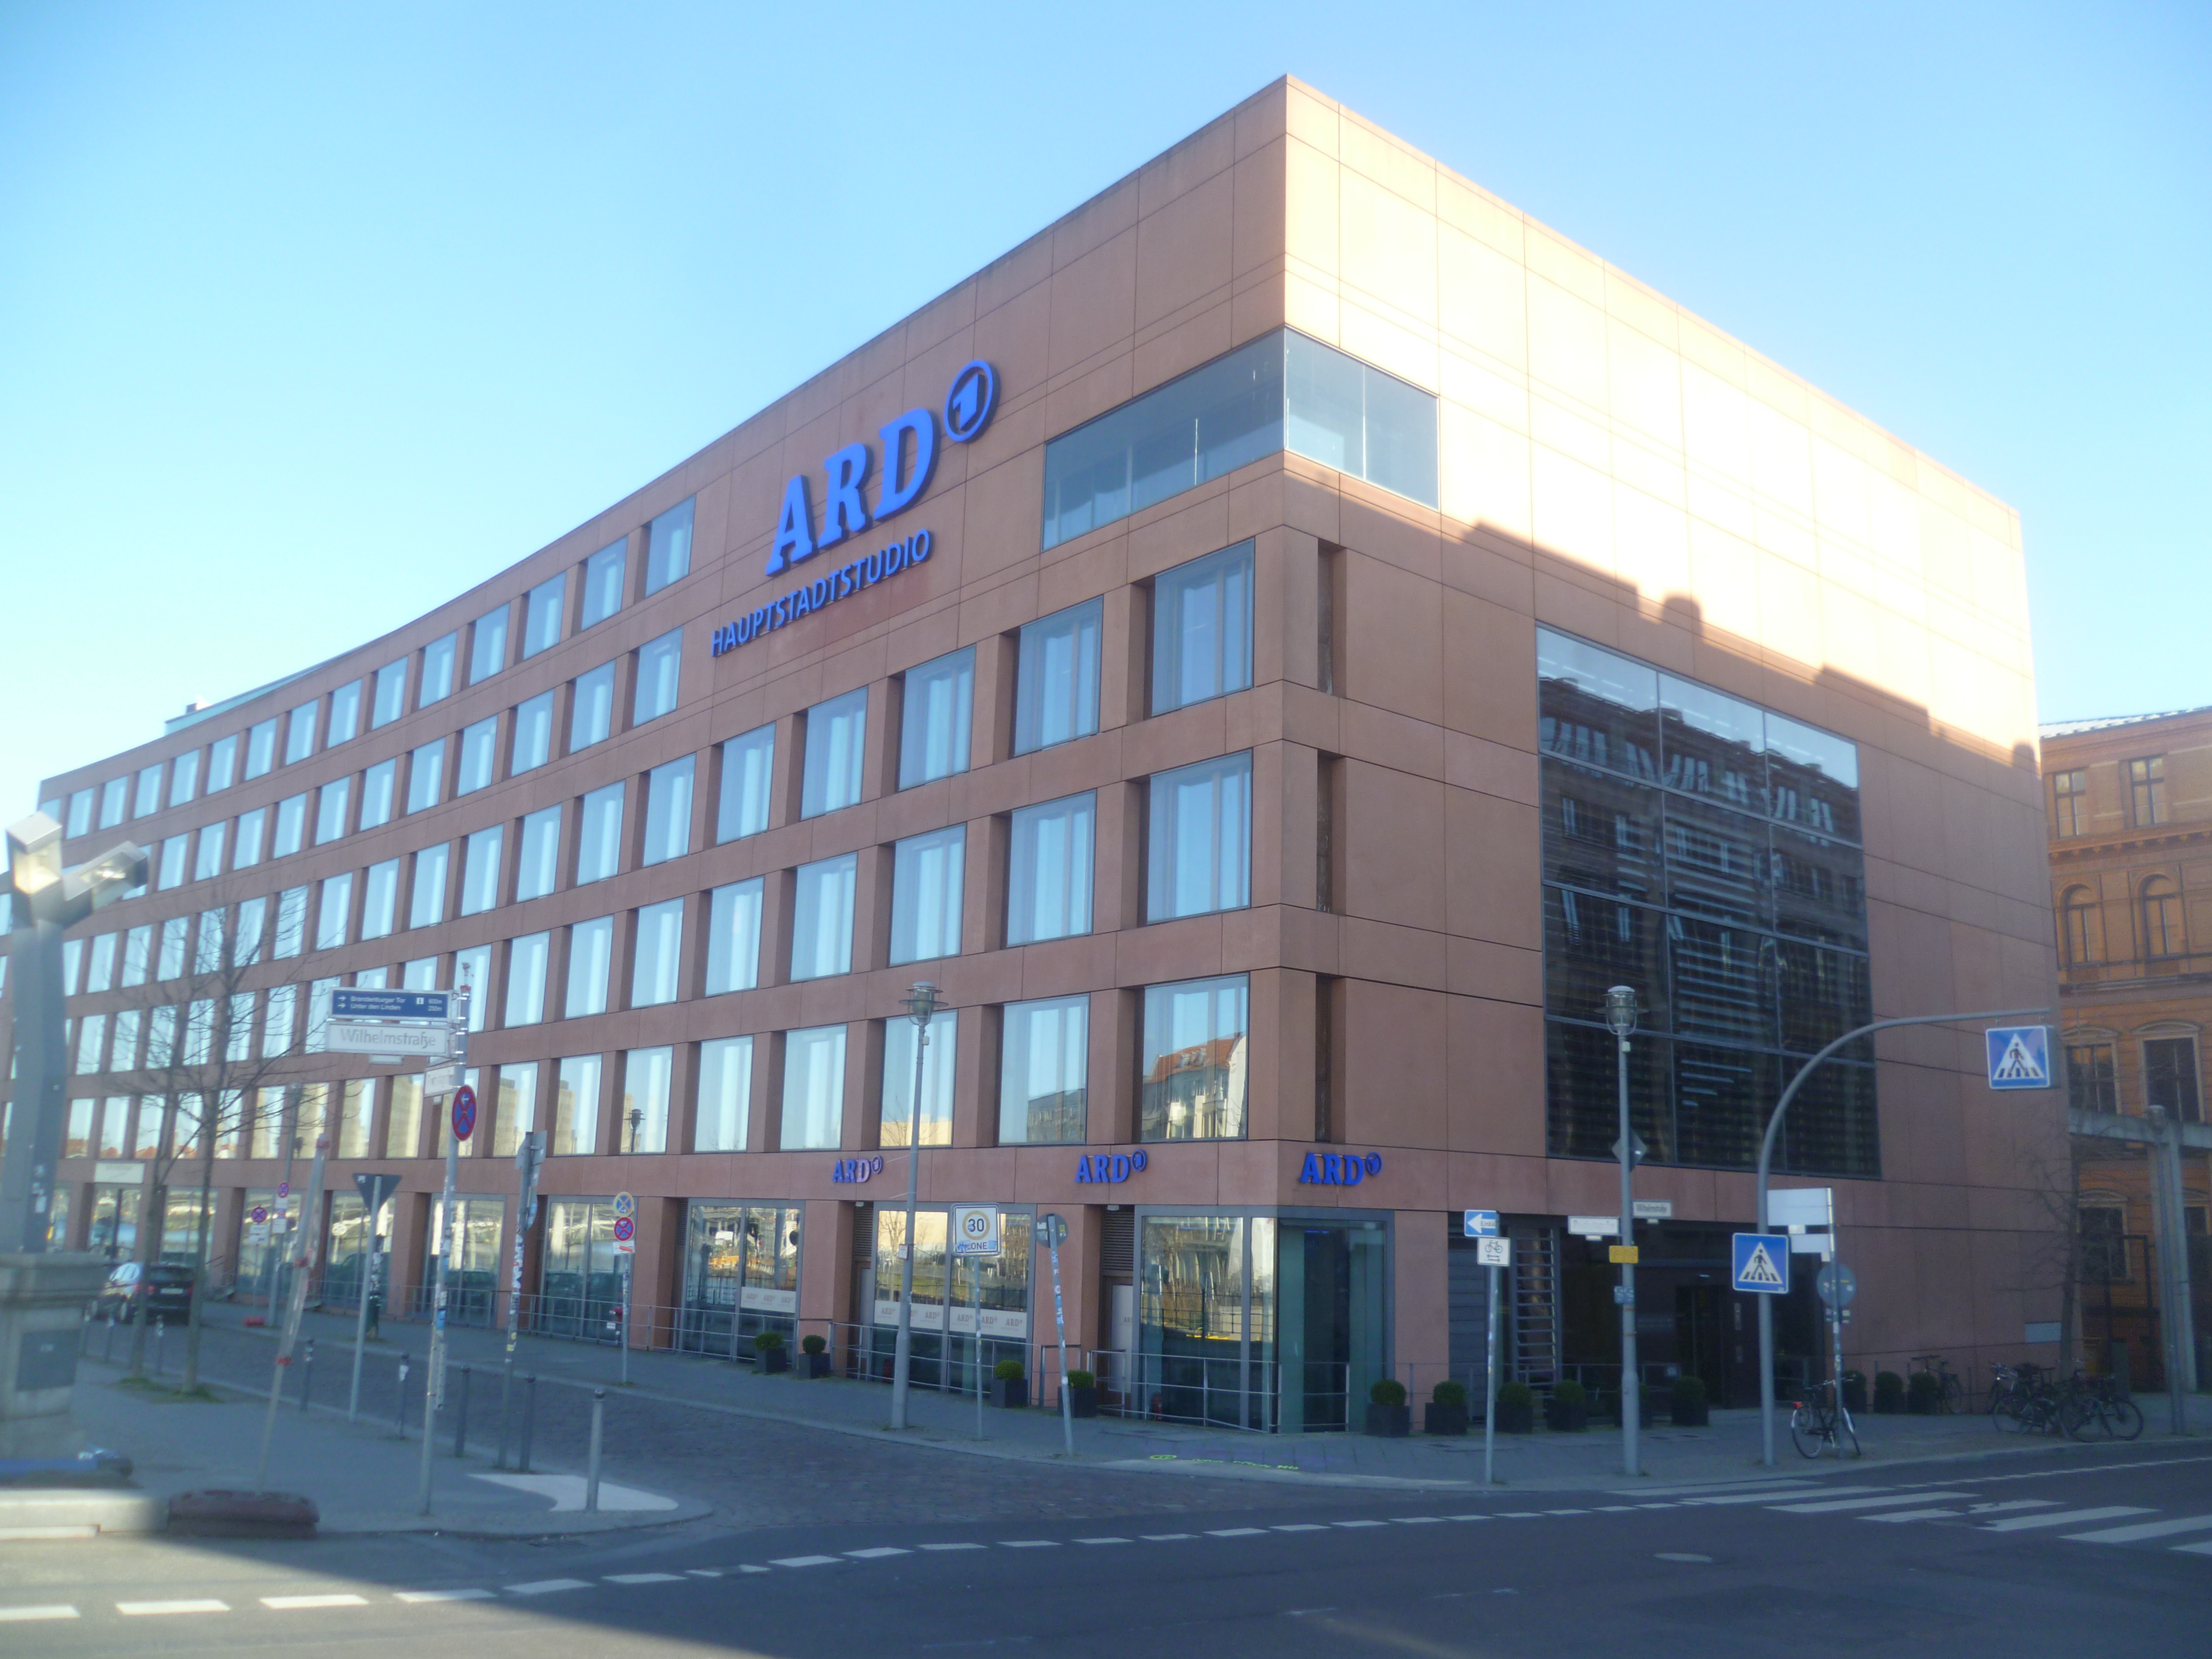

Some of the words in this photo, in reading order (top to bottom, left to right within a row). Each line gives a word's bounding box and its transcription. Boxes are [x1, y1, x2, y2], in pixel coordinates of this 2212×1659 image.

[765, 408, 937, 576] ARD
[711, 528, 931, 657] HAUPTSTADTSTUDIO
[341, 1028, 435, 1049] Wilhelmstraße
[831, 1159, 870, 1183] ARD
[1074, 1154, 1130, 1183] ARD
[1299, 1152, 1365, 1186] ARD
[968, 1219, 984, 1232] 30
